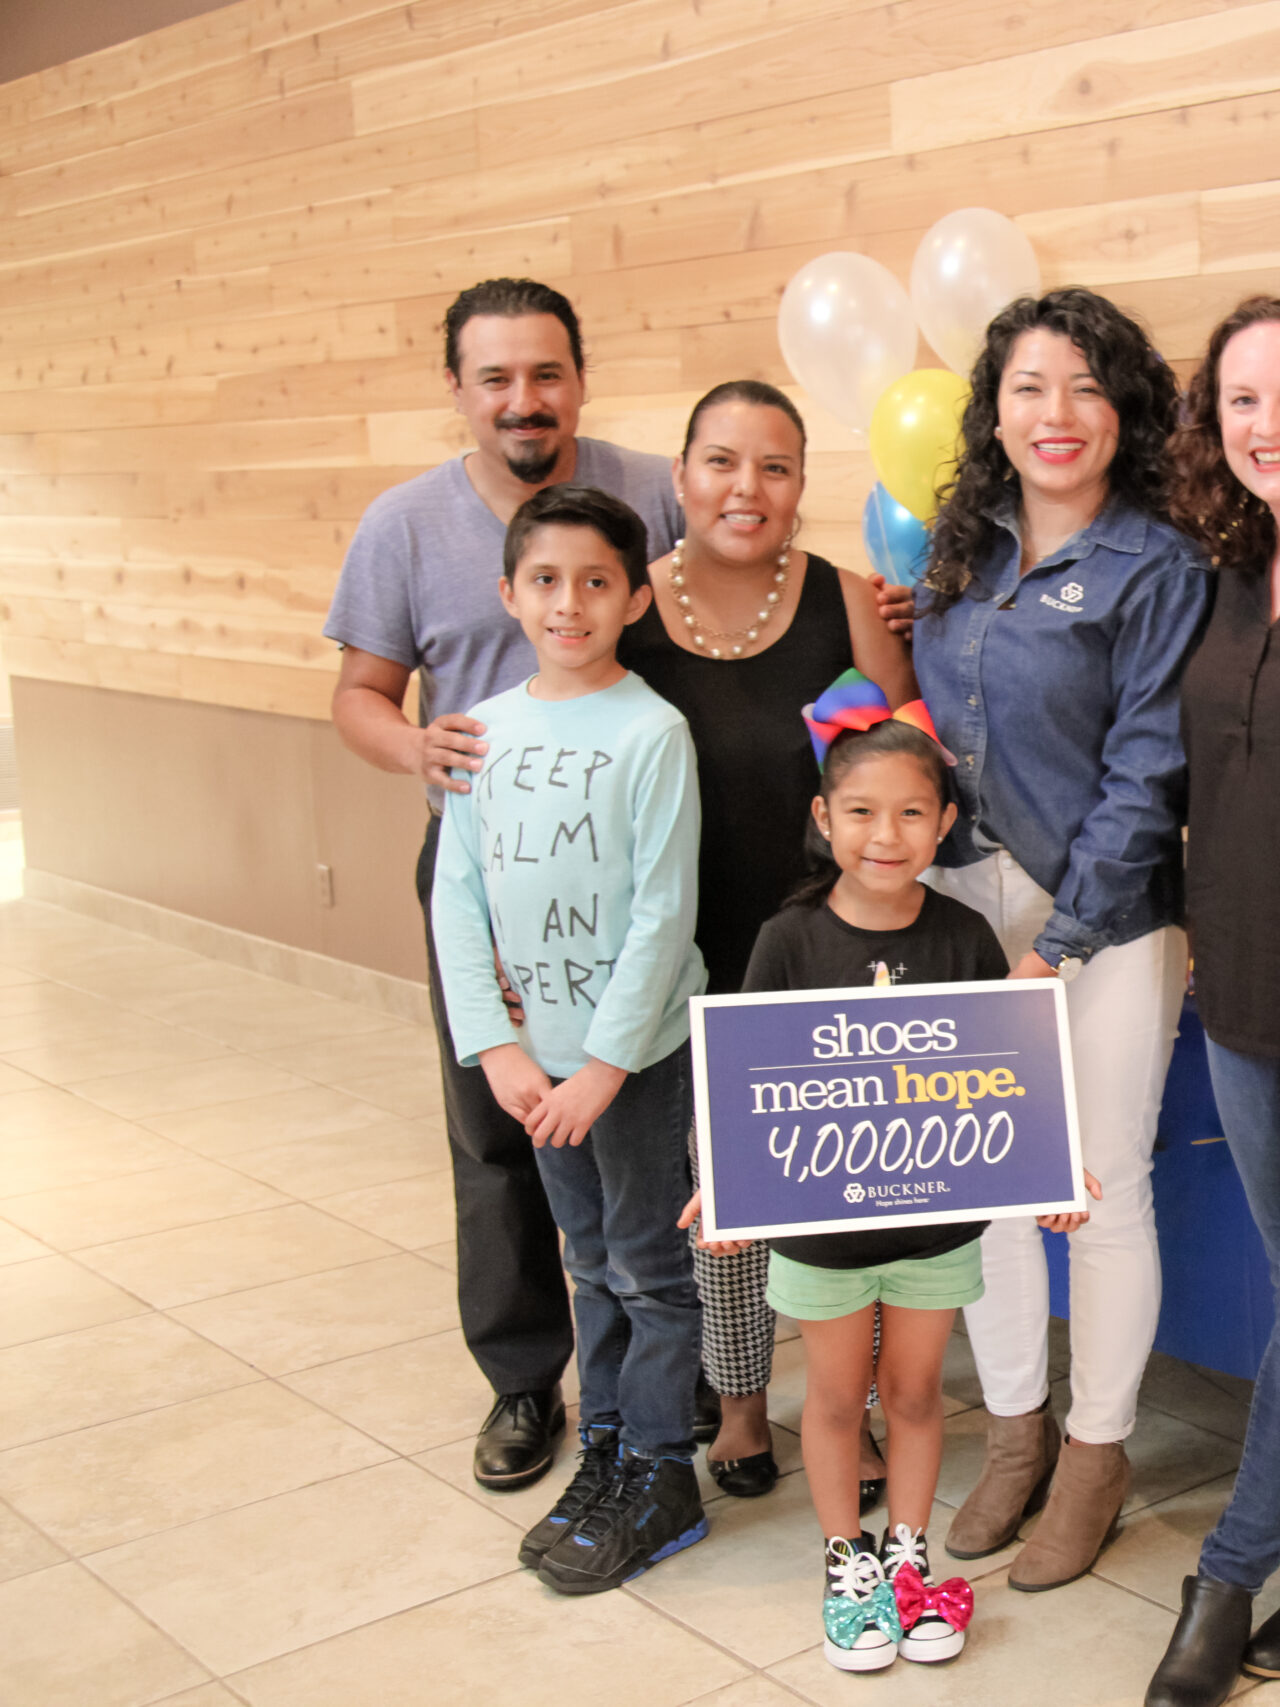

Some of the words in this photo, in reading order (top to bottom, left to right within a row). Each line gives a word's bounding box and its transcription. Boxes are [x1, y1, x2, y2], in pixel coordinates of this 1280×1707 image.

[481, 812, 599, 872] ALM
[542, 893, 599, 943] AN
[504, 959, 617, 1009] PERT
[811, 1013, 958, 1059] shoes
[750, 1074, 888, 1114] mean
[892, 1064, 1026, 1110] hope.
[768, 1110, 1015, 1183] 4,000,000
